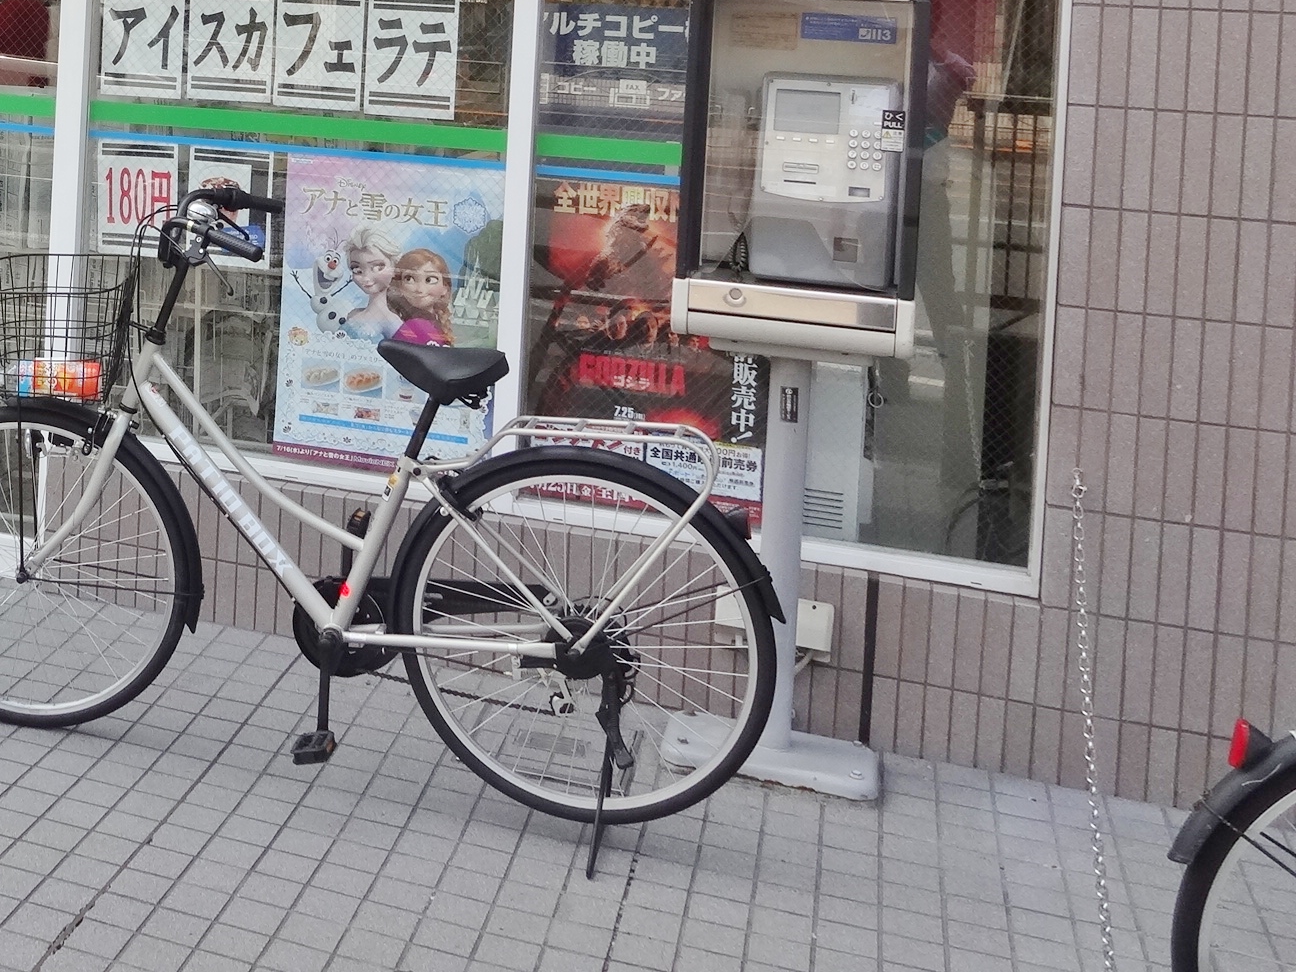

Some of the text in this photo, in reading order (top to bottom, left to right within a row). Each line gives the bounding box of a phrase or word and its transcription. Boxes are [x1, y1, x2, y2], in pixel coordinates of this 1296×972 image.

[542, 12, 690, 41] ルチコピー
[110, 5, 452, 87] アイスカフェラテ
[572, 39, 657, 68] 稼働中
[556, 81, 686, 101] コピー FAX ファ
[883, 121, 903, 129] PULL
[884, 112, 904, 121] ひく
[105, 167, 171, 226] 180円
[300, 187, 448, 227] アナと雪の女王
[578, 352, 686, 397] GODZILLA
[613, 375, 652, 391] ゴジラ
[650, 447, 758, 473] 全国共通前売券
